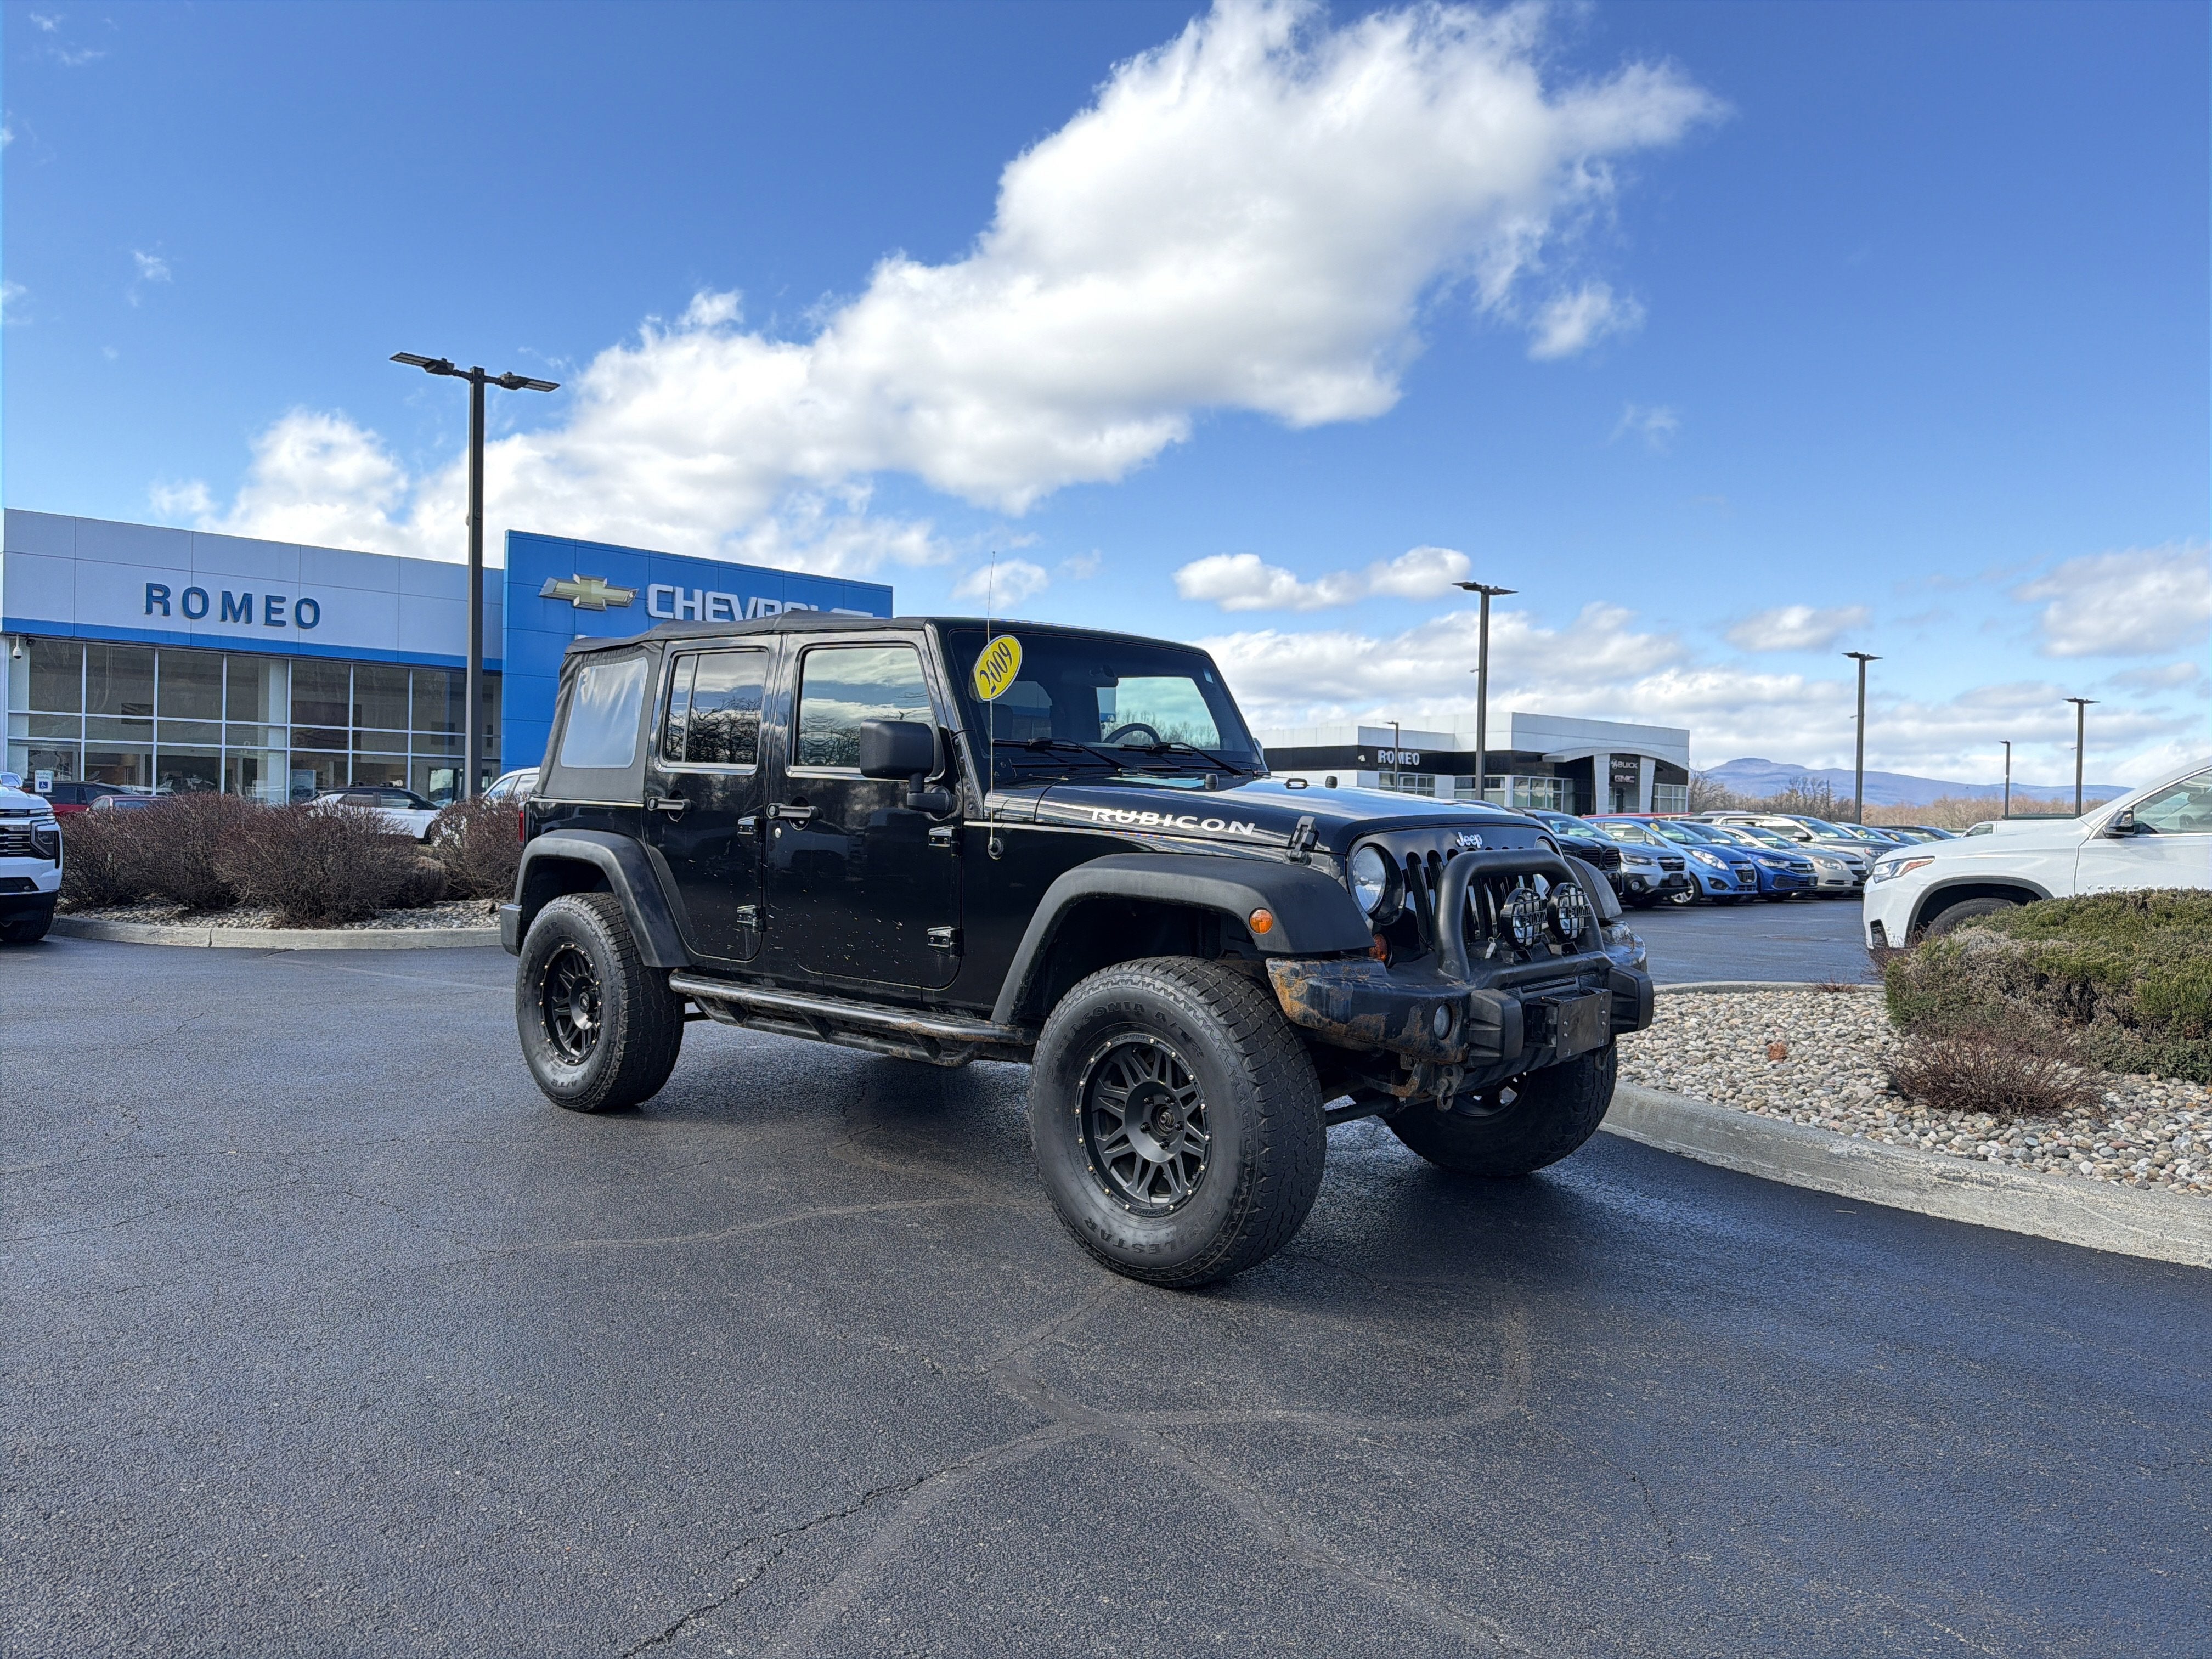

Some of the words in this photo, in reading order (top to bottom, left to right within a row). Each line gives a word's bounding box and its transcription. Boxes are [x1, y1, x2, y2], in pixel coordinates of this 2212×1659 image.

[145, 583, 320, 629] ROMEO
[647, 583, 873, 622] CHEVR
[979, 641, 1012, 695] 2009
[1378, 750, 1420, 765] ROMEO
[1614, 775, 1635, 783] GMC
[1091, 808, 1255, 836] RUBICON
[1456, 832, 1483, 849] Jeep
[1523, 911, 1547, 927] PIAA
[1568, 905, 1591, 918] PIAA
[1046, 1001, 1146, 1084] PATAGONIA
[1084, 1217, 1204, 1256] MILESTAR
